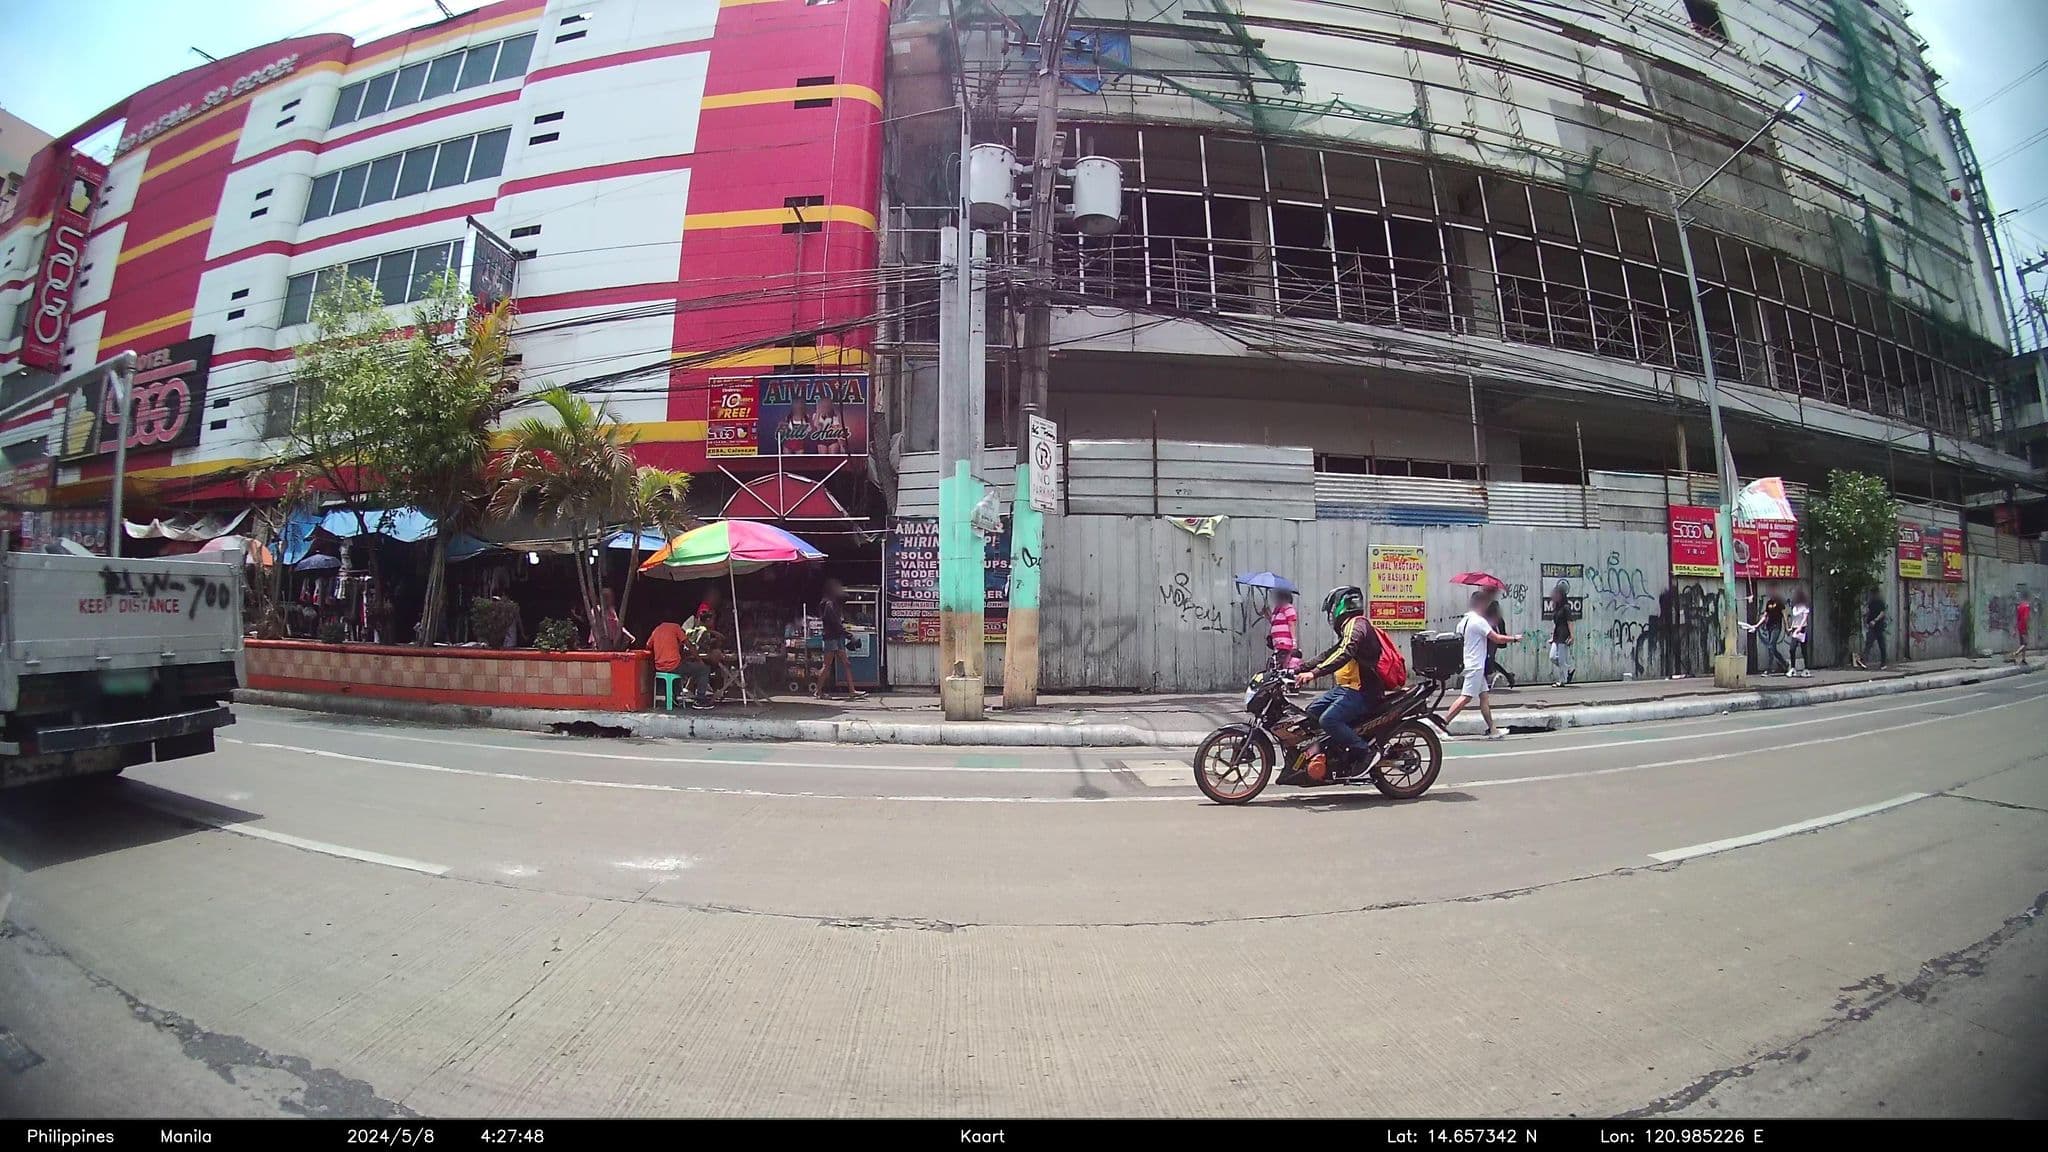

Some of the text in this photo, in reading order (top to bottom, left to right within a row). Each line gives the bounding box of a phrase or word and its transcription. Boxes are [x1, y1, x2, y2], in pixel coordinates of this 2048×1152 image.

[34, 225, 86, 344] SOGO
[136, 347, 173, 371] OTEL
[762, 378, 866, 406] AMAYA
[717, 407, 751, 419] FREE!
[895, 523, 940, 535] AMAYA
[1672, 520, 1702, 539] SOGO
[904, 536, 940, 548] HIRIN
[901, 552, 932, 560] SOLO
[1766, 565, 1795, 577] FREE!
[79, 599, 180, 613] KEEP DISTANCE
